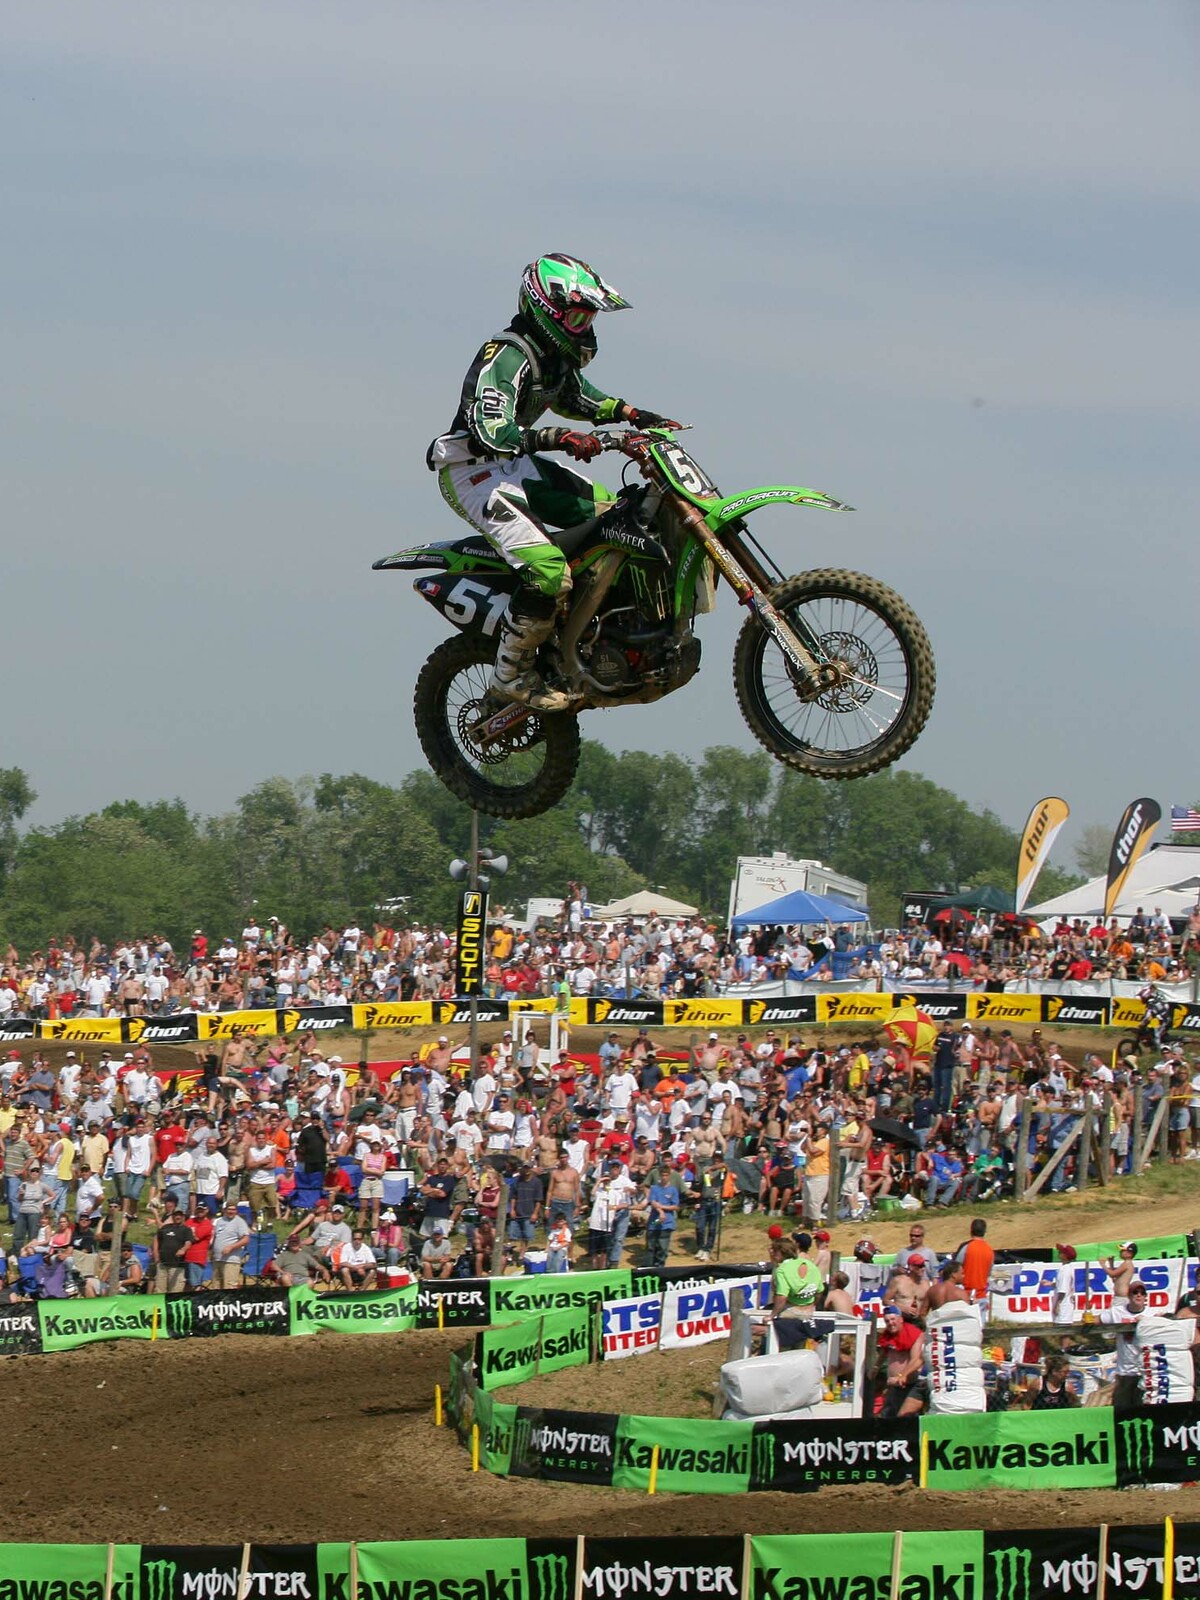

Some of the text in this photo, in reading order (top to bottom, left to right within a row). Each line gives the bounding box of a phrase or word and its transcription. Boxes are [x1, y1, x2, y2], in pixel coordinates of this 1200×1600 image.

[666, 449, 702, 494] 5
[720, 498, 745, 518] PRO
[746, 490, 799, 504] CIRCUIT
[462, 546, 499, 558] Kawasak
[601, 526, 646, 550] MONSTER
[444, 577, 512, 636] 51
[1026, 804, 1049, 862] thor
[1116, 804, 1143, 865] thor
[460, 918, 481, 993] SCOTT
[297, 1017, 345, 1030] thor
[375, 1014, 423, 1025] thor
[607, 1008, 655, 1021] thor
[686, 1010, 732, 1022] thor
[763, 1007, 810, 1020] thor
[837, 1004, 883, 1016] thor
[988, 1005, 1032, 1016] thor
[1058, 1006, 1102, 1020] thor
[1116, 1009, 1146, 1022] tho
[143, 1025, 190, 1038] thor
[198, 1300, 287, 1321] MONSTER
[417, 1290, 486, 1307] NSTER
[495, 1283, 627, 1312] Kawasaki
[44, 1309, 163, 1337] Kawasaki
[212, 1319, 276, 1331] ENERGY
[486, 1324, 588, 1375] Kawasaki
[531, 1425, 613, 1457] MONSTER
[782, 1437, 913, 1466] MONSTER
[928, 1431, 1110, 1472] Kawasaki
[618, 1437, 748, 1475] Kawasaki
[805, 1470, 894, 1481] ENERGY
[182, 1566, 311, 1600] MONSTER
[581, 1560, 739, 1598] MONSTER
[753, 1563, 975, 1600] Kawasaki
[1042, 1551, 1200, 1594] MONSTE
